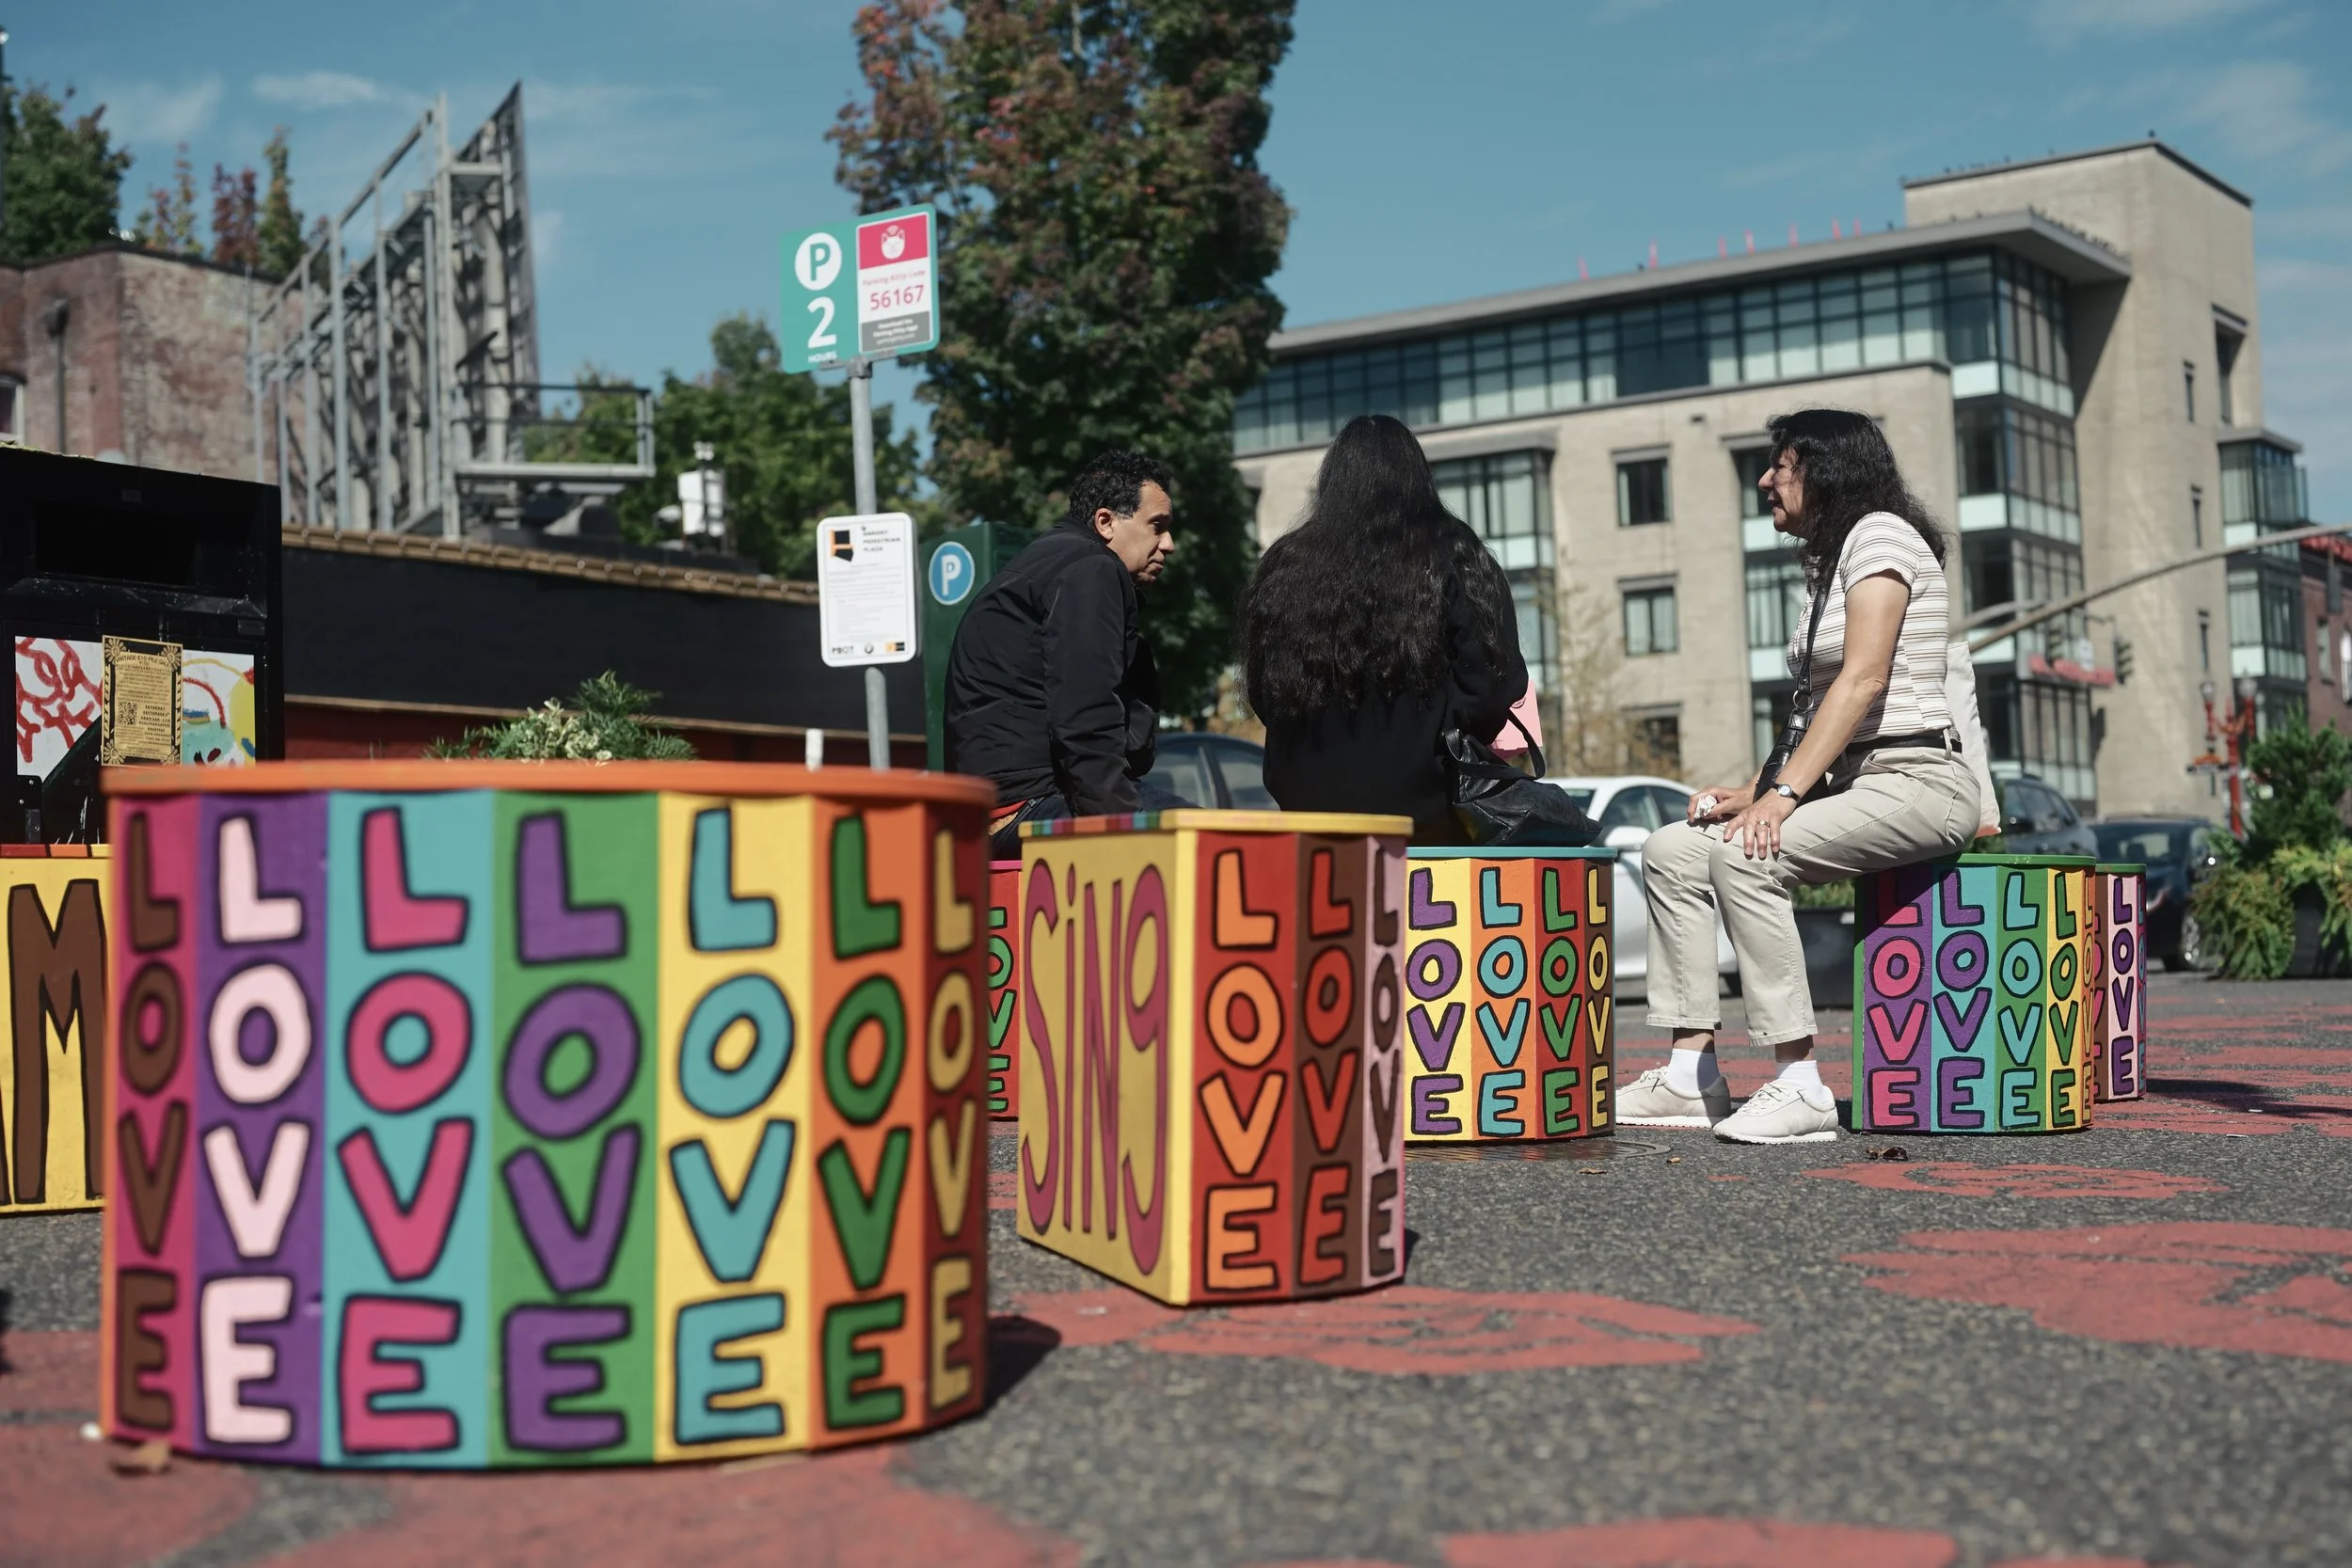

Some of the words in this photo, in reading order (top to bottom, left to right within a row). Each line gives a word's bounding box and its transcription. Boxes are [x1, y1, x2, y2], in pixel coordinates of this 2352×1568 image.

[807, 296, 837, 349] 2
[808, 351, 837, 363] HOURS
[869, 284, 924, 310] 56167
[118, 810, 187, 1431] LOVE
[929, 829, 976, 1408] LOVE
[1199, 848, 1287, 1292] LOVE
[1297, 848, 1359, 1285] LOVE
[1369, 848, 1400, 1277] LOVE
[1405, 867, 1466, 1136] LOVE
[1475, 866, 1531, 1136] LOVE
[1539, 866, 1583, 1136] LOVE
[1586, 865, 1612, 1129] LOVE
[1866, 869, 1929, 1129] LOVE
[1933, 868, 1993, 1129] LOVE
[1997, 871, 2044, 1129] LOVE
[2049, 870, 2079, 1129] LOVE
[2081, 876, 2094, 1124] LOVE
[2111, 877, 2135, 1096] LOVE
[200, 813, 313, 1444] LOVE
[336, 806, 475, 1454] LOVE
[499, 807, 643, 1454] LOVE
[667, 804, 796, 1446] LOVE
[816, 813, 913, 1431] LOVE
